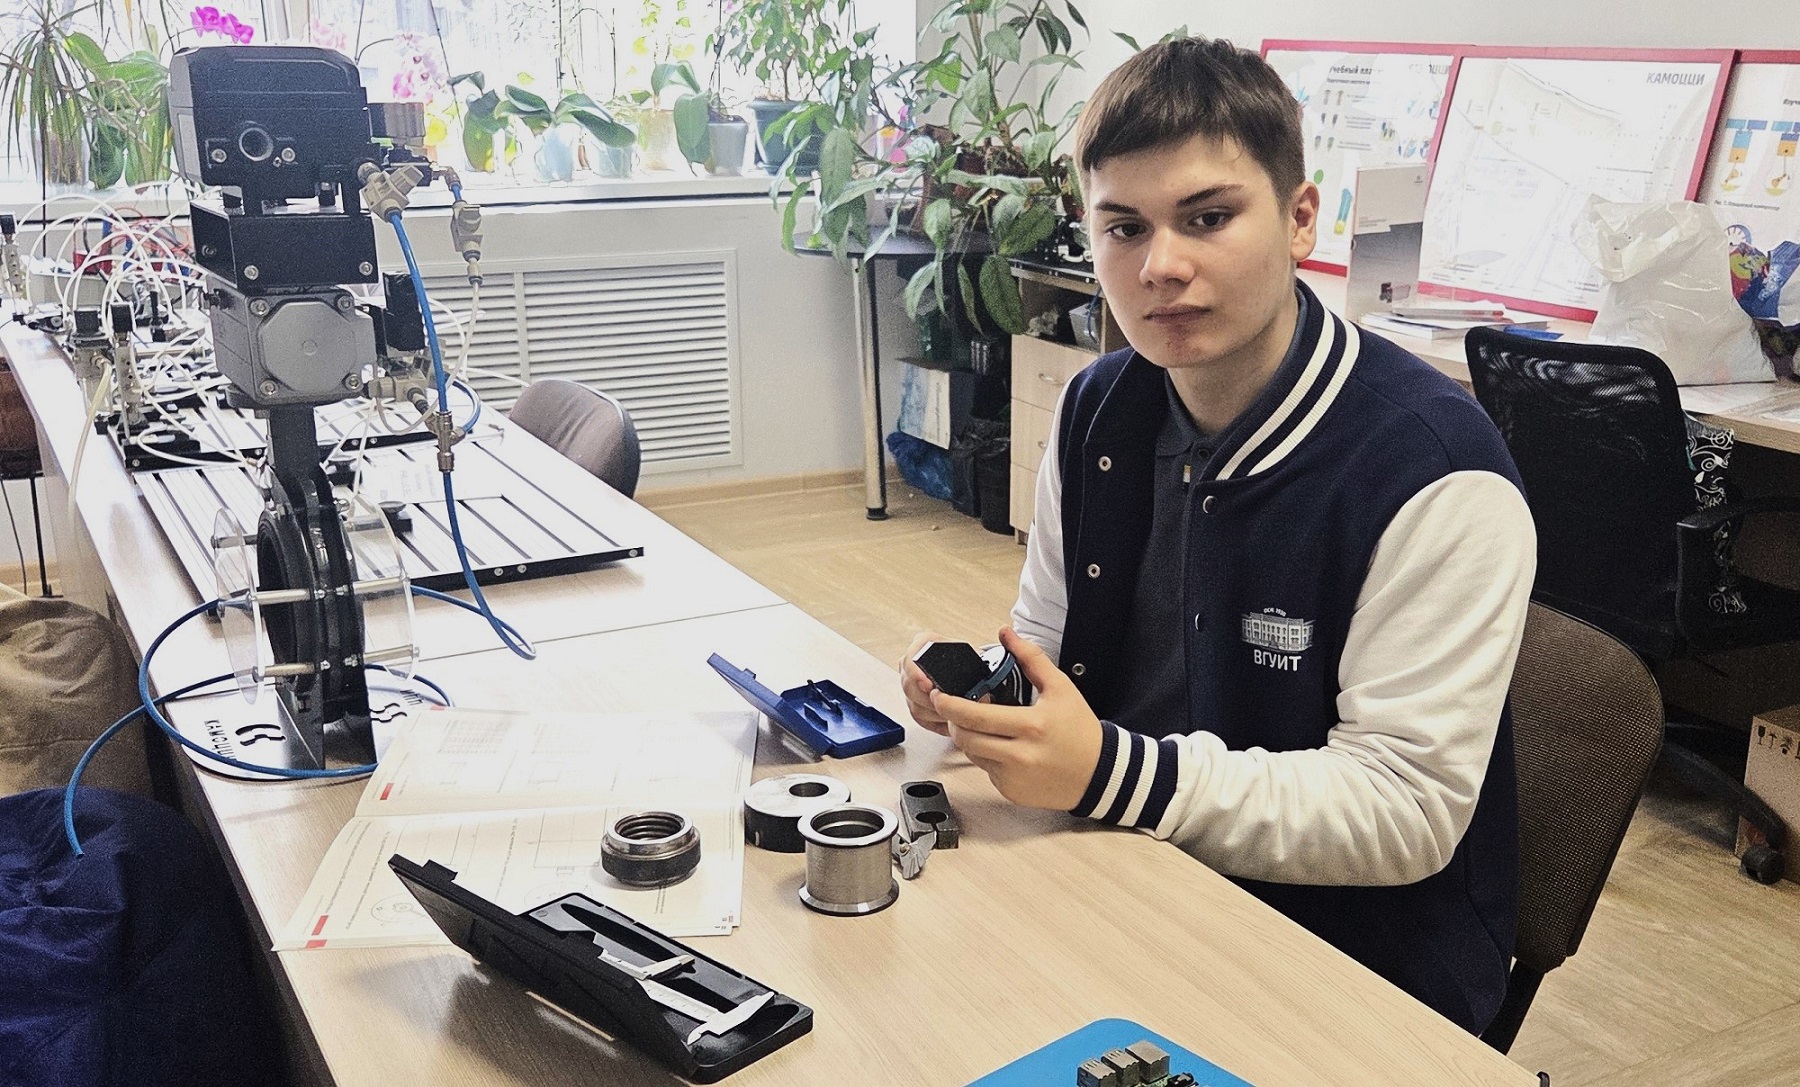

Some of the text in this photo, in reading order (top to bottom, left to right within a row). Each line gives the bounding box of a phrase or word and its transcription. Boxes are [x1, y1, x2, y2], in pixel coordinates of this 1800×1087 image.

[1646, 72, 1705, 86] КАМОЦЦИ
[1253, 649, 1302, 671] ВГУИТ
[204, 720, 236, 760] КАМОЦЦ
